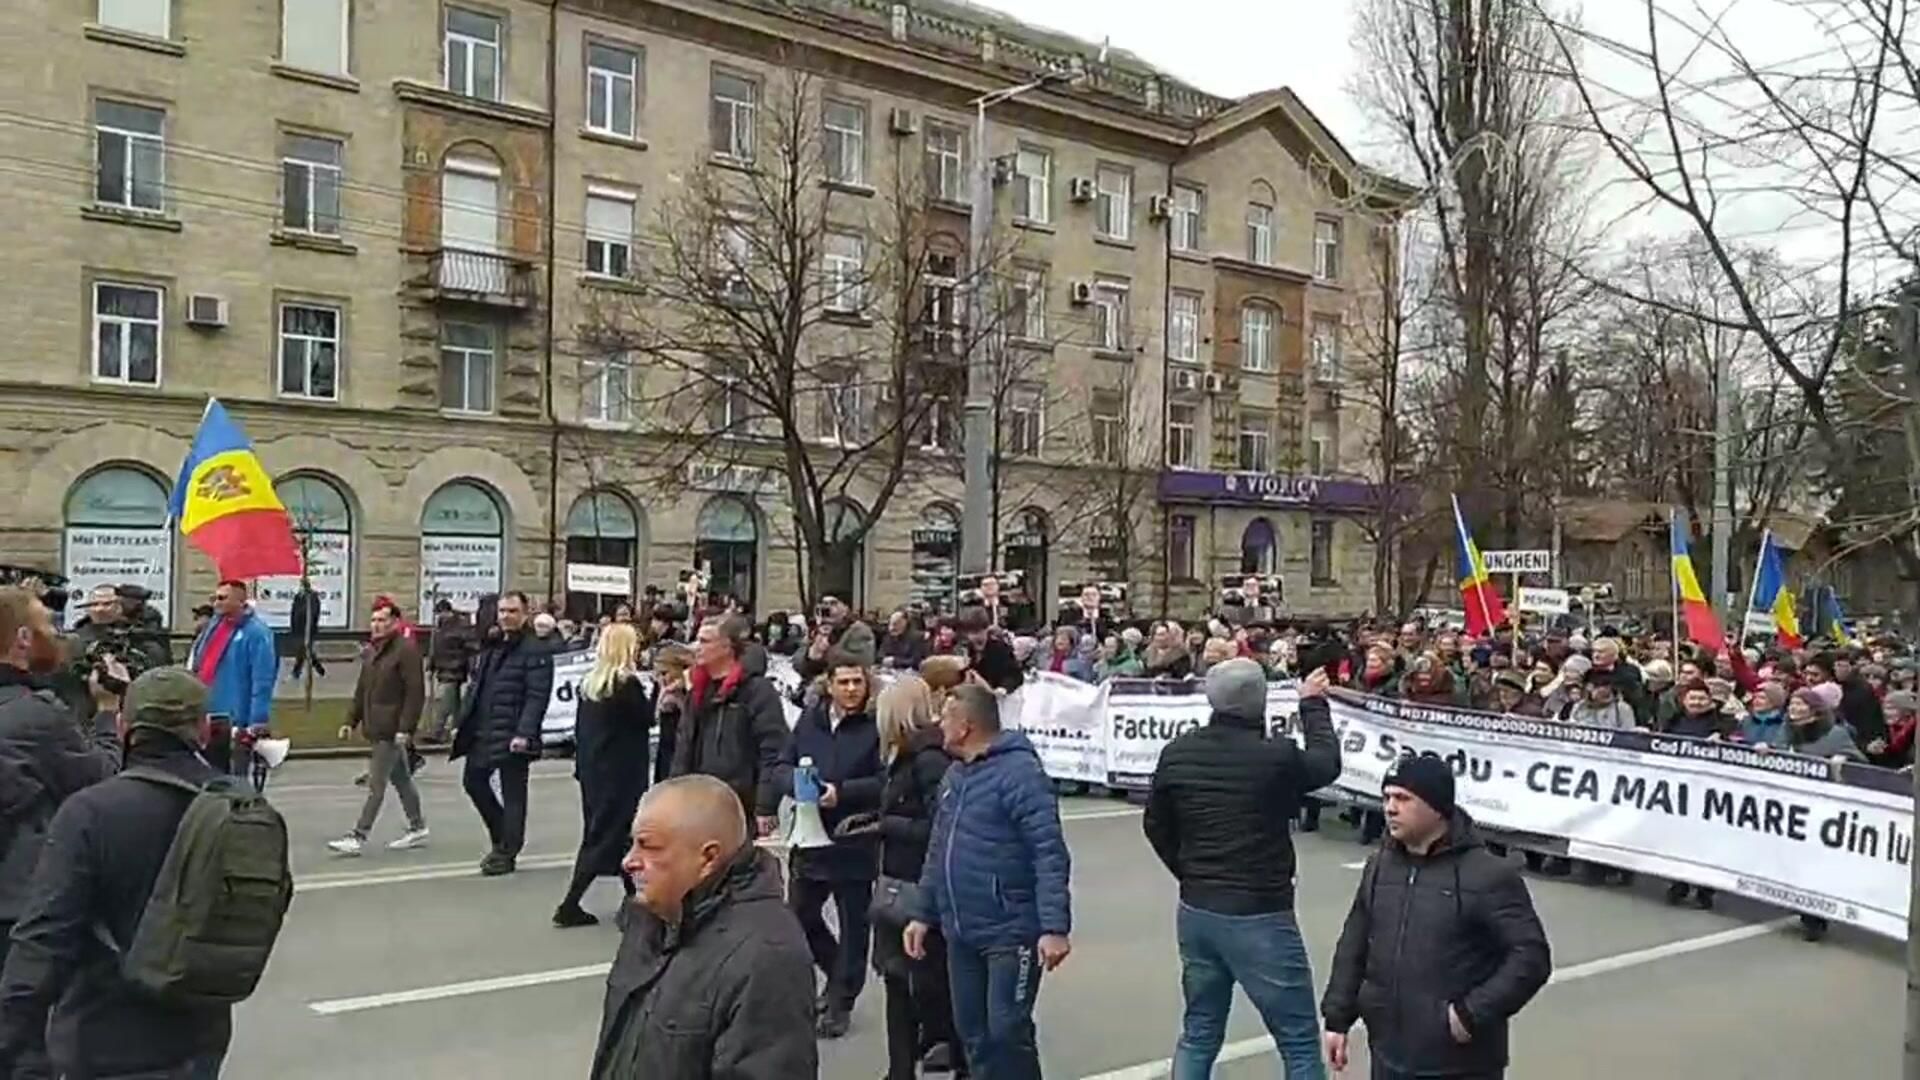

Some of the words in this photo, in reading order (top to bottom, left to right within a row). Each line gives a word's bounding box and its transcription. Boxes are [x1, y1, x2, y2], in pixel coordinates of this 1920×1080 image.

[1484, 552, 1547, 569] UNGHENI
[1113, 714, 1200, 740] Factura
[1526, 761, 1600, 802] CEA
[1610, 774, 1690, 817] MAI
[1702, 788, 1811, 842] MARE
[1819, 810, 1879, 859] din
